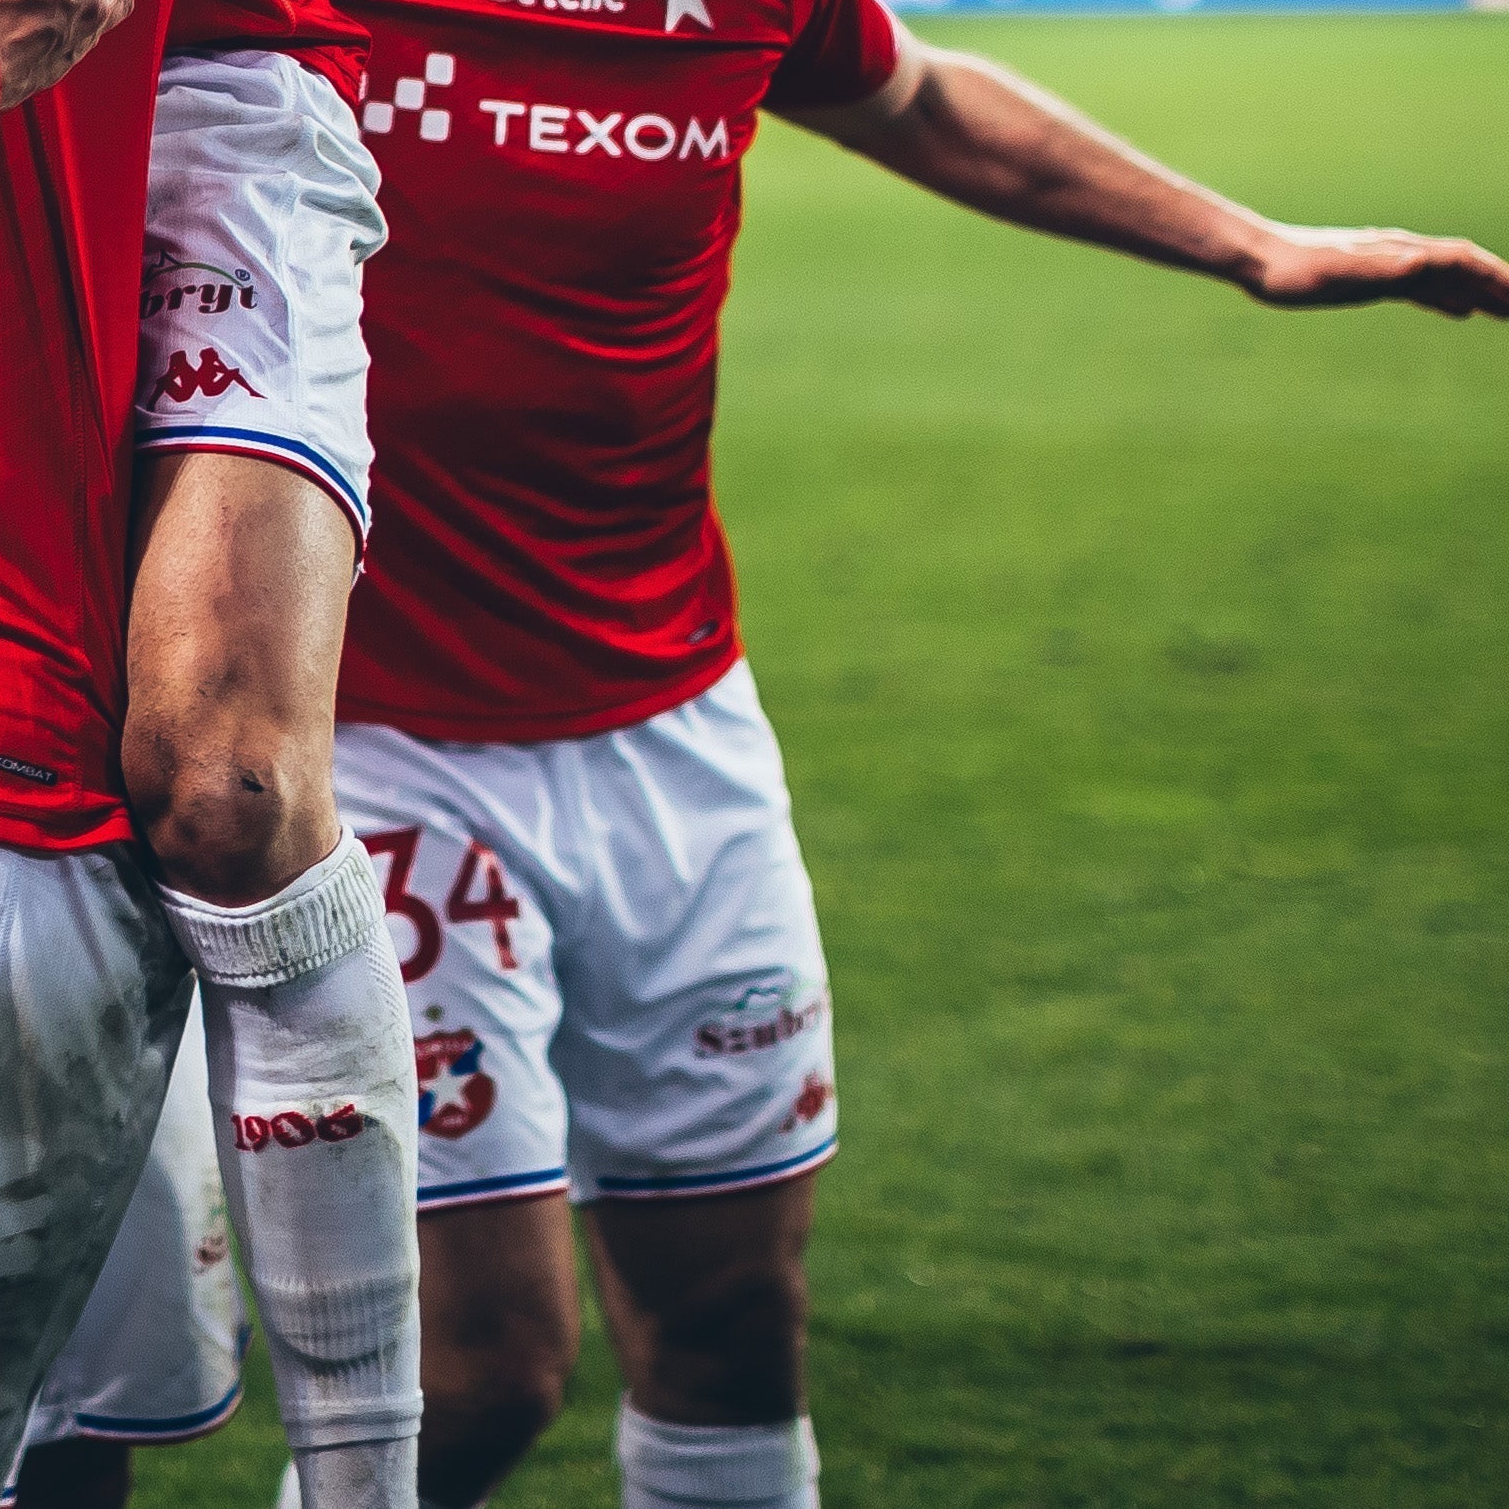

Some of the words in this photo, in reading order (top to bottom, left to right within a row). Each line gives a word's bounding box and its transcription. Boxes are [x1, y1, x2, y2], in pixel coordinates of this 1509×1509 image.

[479, 98, 730, 161] TEXOM
[139, 283, 259, 320] bryt
[355, 825, 522, 984] 34
[231, 1103, 364, 1153] 1906
